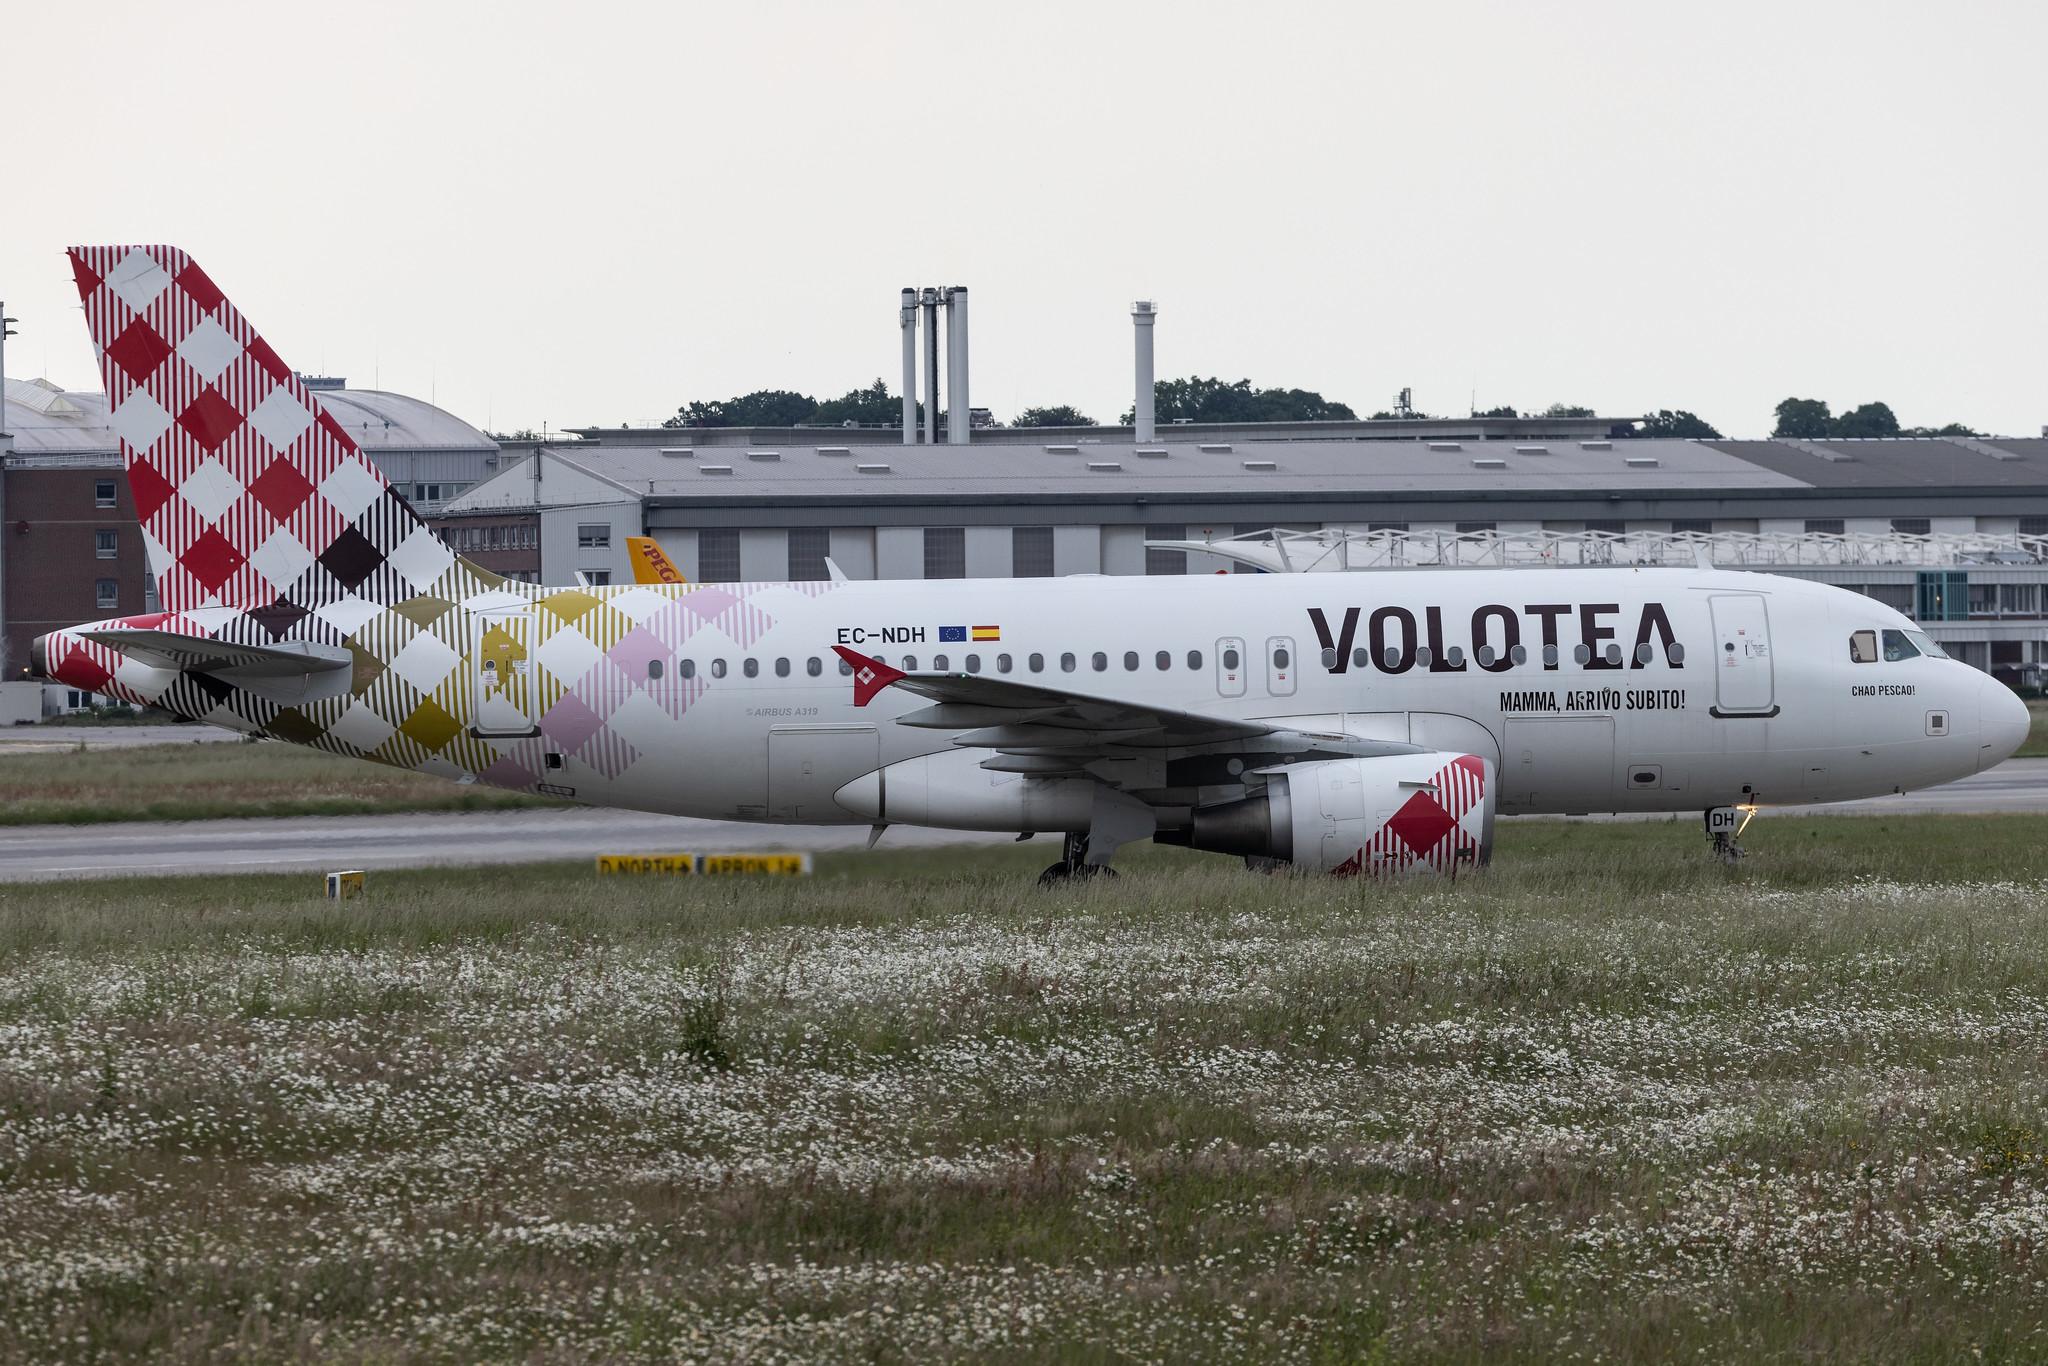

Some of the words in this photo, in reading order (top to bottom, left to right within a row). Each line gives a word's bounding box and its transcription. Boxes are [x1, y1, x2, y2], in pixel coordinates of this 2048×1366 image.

[643, 545, 683, 584] PEG
[837, 626, 925, 644] EC-NDH
[1306, 602, 1685, 674] VOLOTEA
[1851, 685, 1876, 697] CHAO
[1878, 684, 1916, 696] PESCAO!
[1500, 691, 1561, 713] MAMMA,
[1565, 689, 1621, 711] ARRIVO
[1626, 689, 1686, 710] SUBITO!
[753, 708, 793, 717] AIRBUS
[795, 707, 819, 716] A319
[1712, 812, 1735, 826] DH
